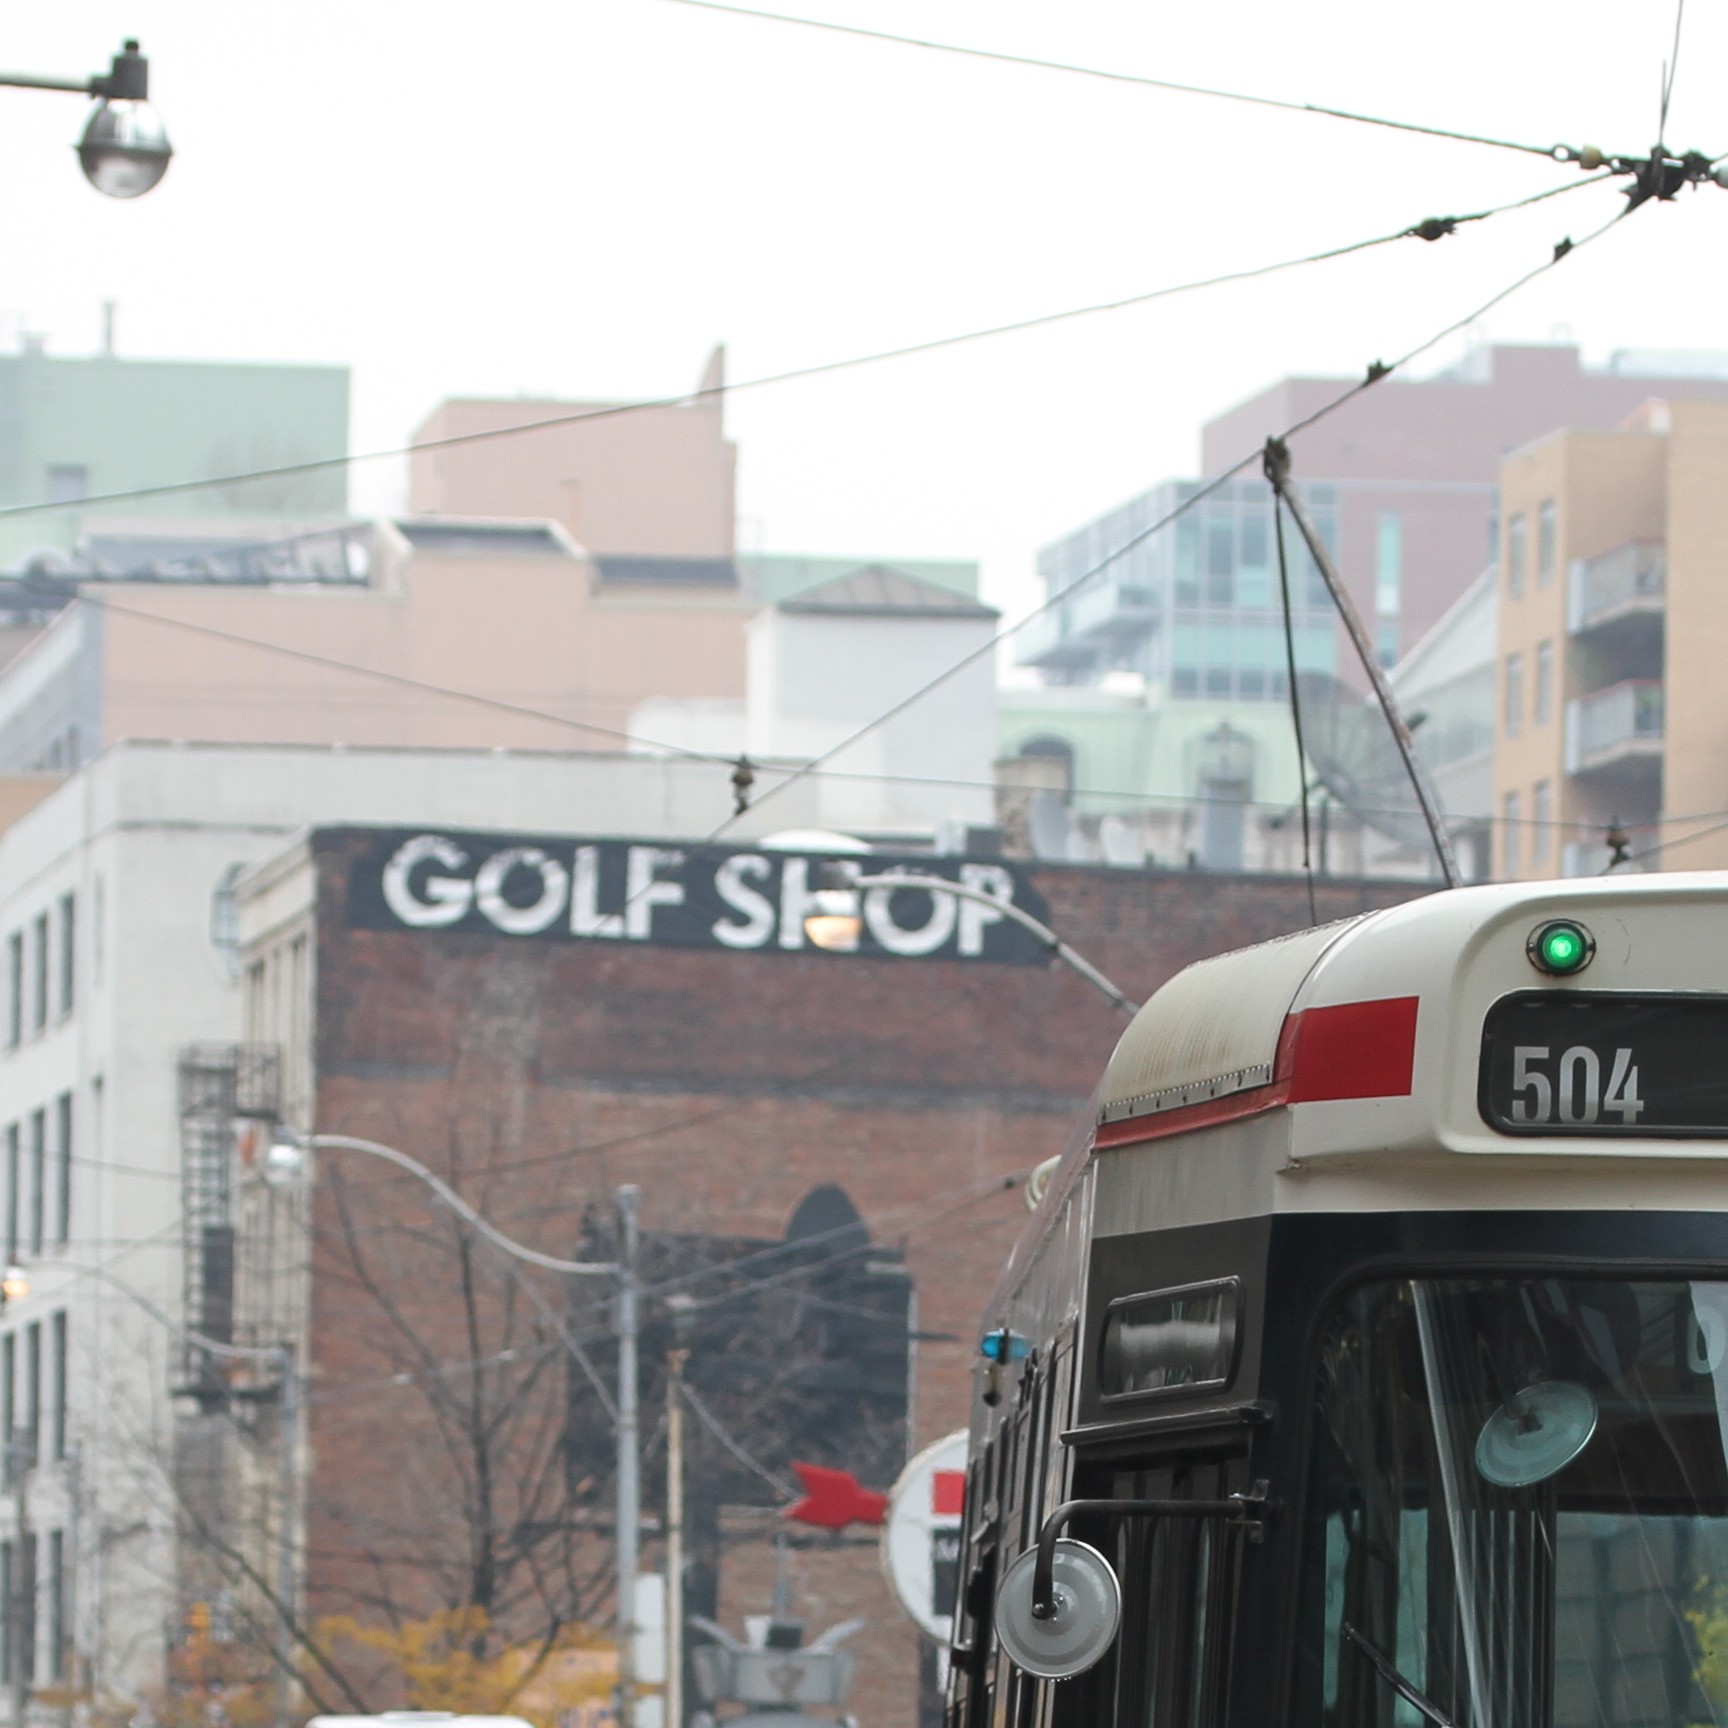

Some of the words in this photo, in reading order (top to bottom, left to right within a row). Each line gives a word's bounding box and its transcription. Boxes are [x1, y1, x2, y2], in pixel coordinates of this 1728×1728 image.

[381, 834, 686, 940] GOLF
[712, 853, 1016, 957] SHOP
[1511, 1045, 1645, 1126] 504
